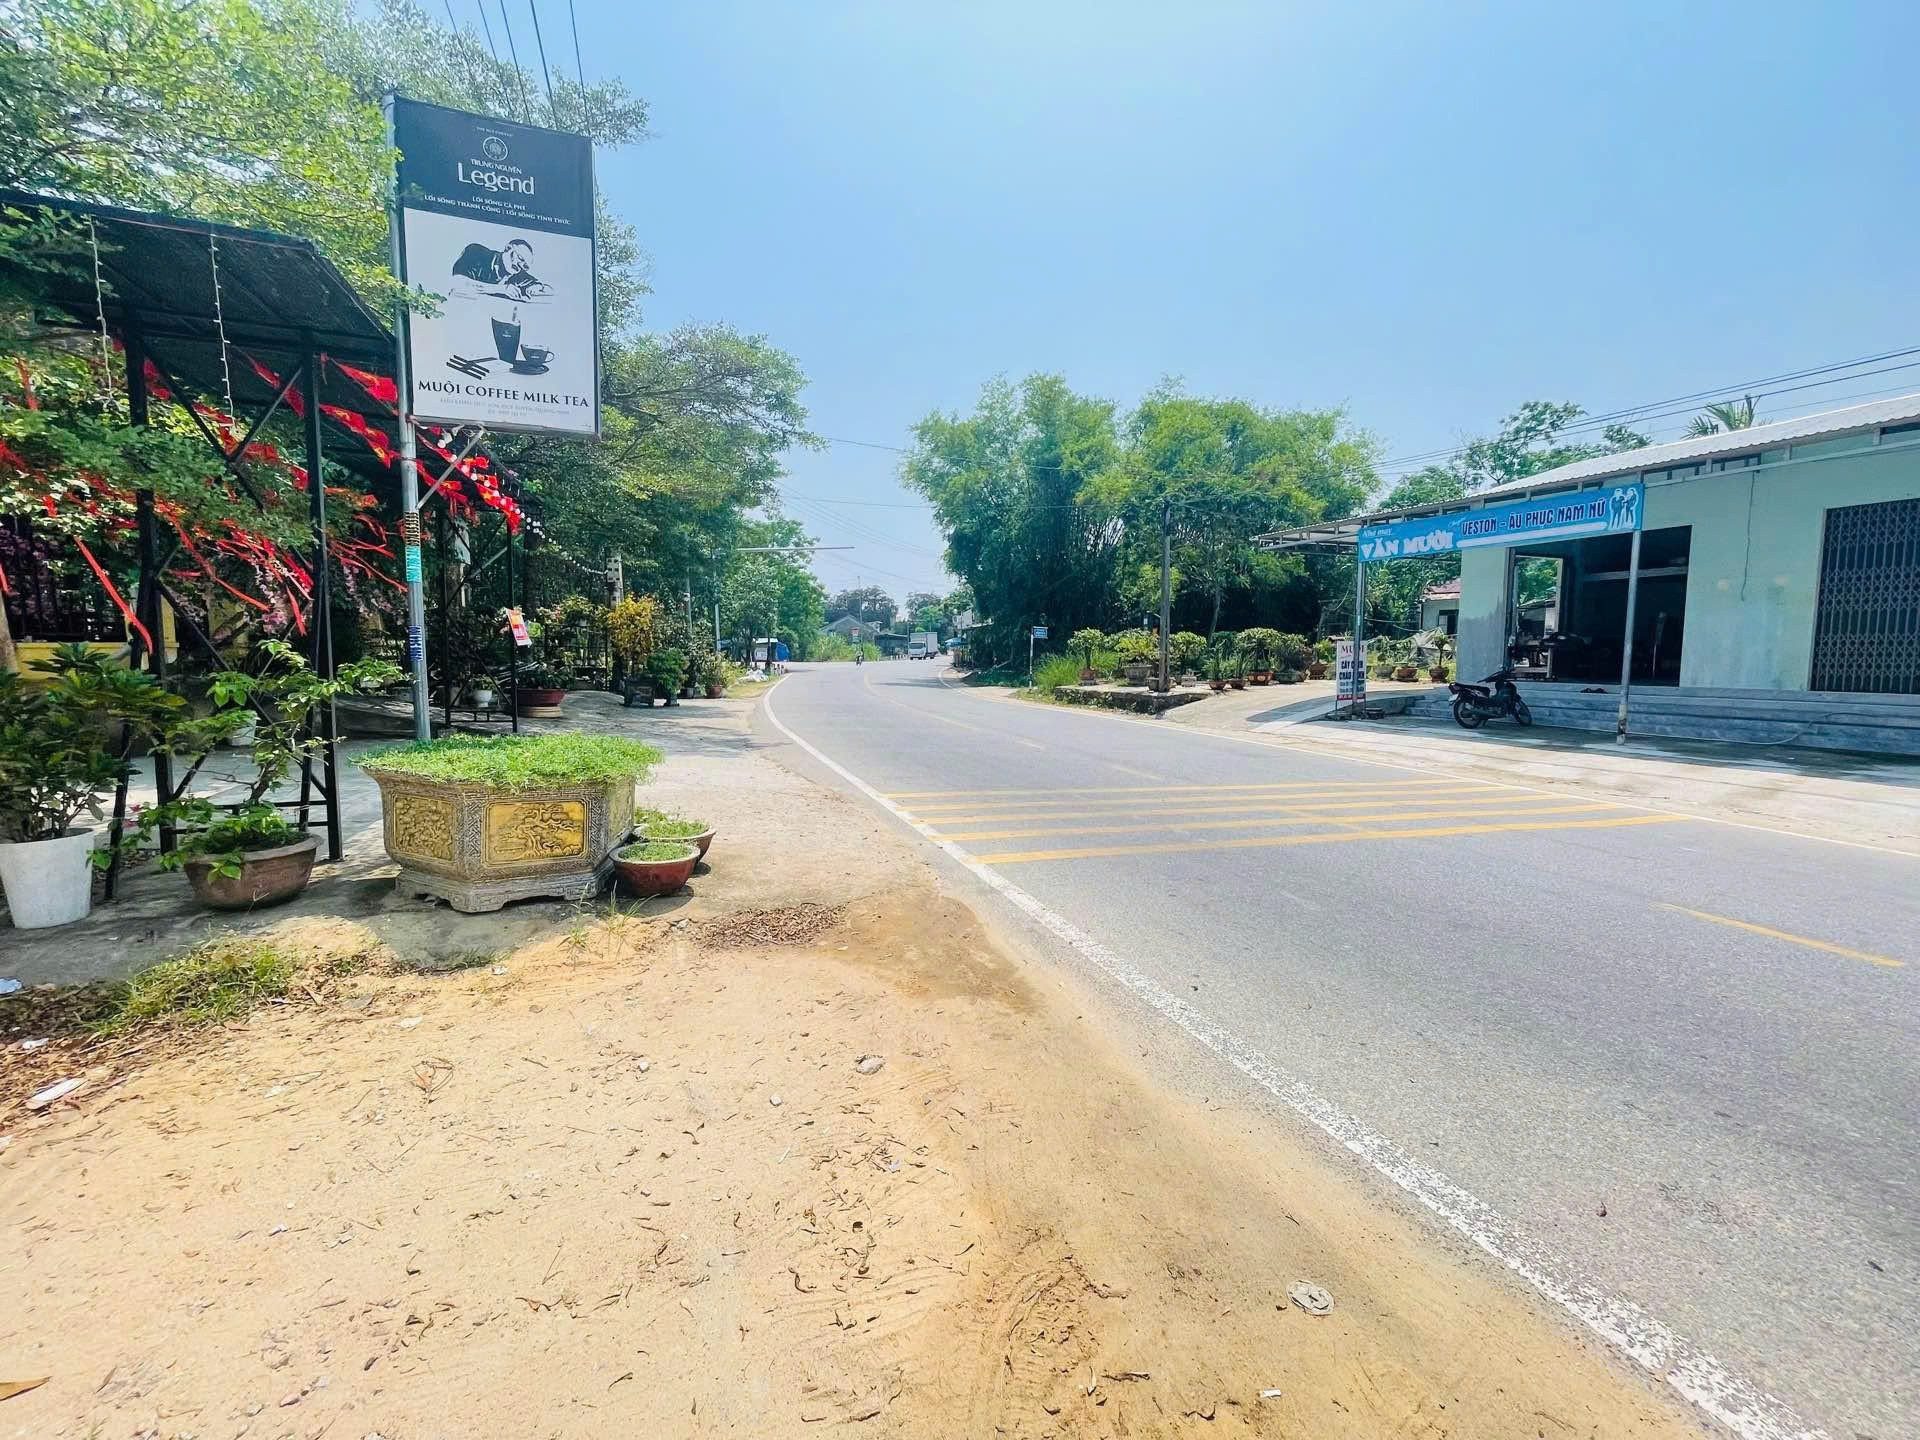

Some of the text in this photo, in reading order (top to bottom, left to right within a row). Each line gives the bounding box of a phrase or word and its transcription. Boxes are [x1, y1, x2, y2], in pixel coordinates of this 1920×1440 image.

[470, 158, 494, 169] TRUNG
[457, 162, 535, 196] Legend
[418, 379, 460, 396] MUỘI
[465, 385, 519, 401] COFFEE
[523, 391, 560, 405] MILK
[563, 395, 590, 408] TEA
[1462, 518, 1497, 536] VESTON
[1508, 512, 1522, 529] ÂU
[1525, 509, 1553, 528] PHỤC
[1556, 504, 1585, 523] NAM
[1361, 537, 1400, 559] VĂN
